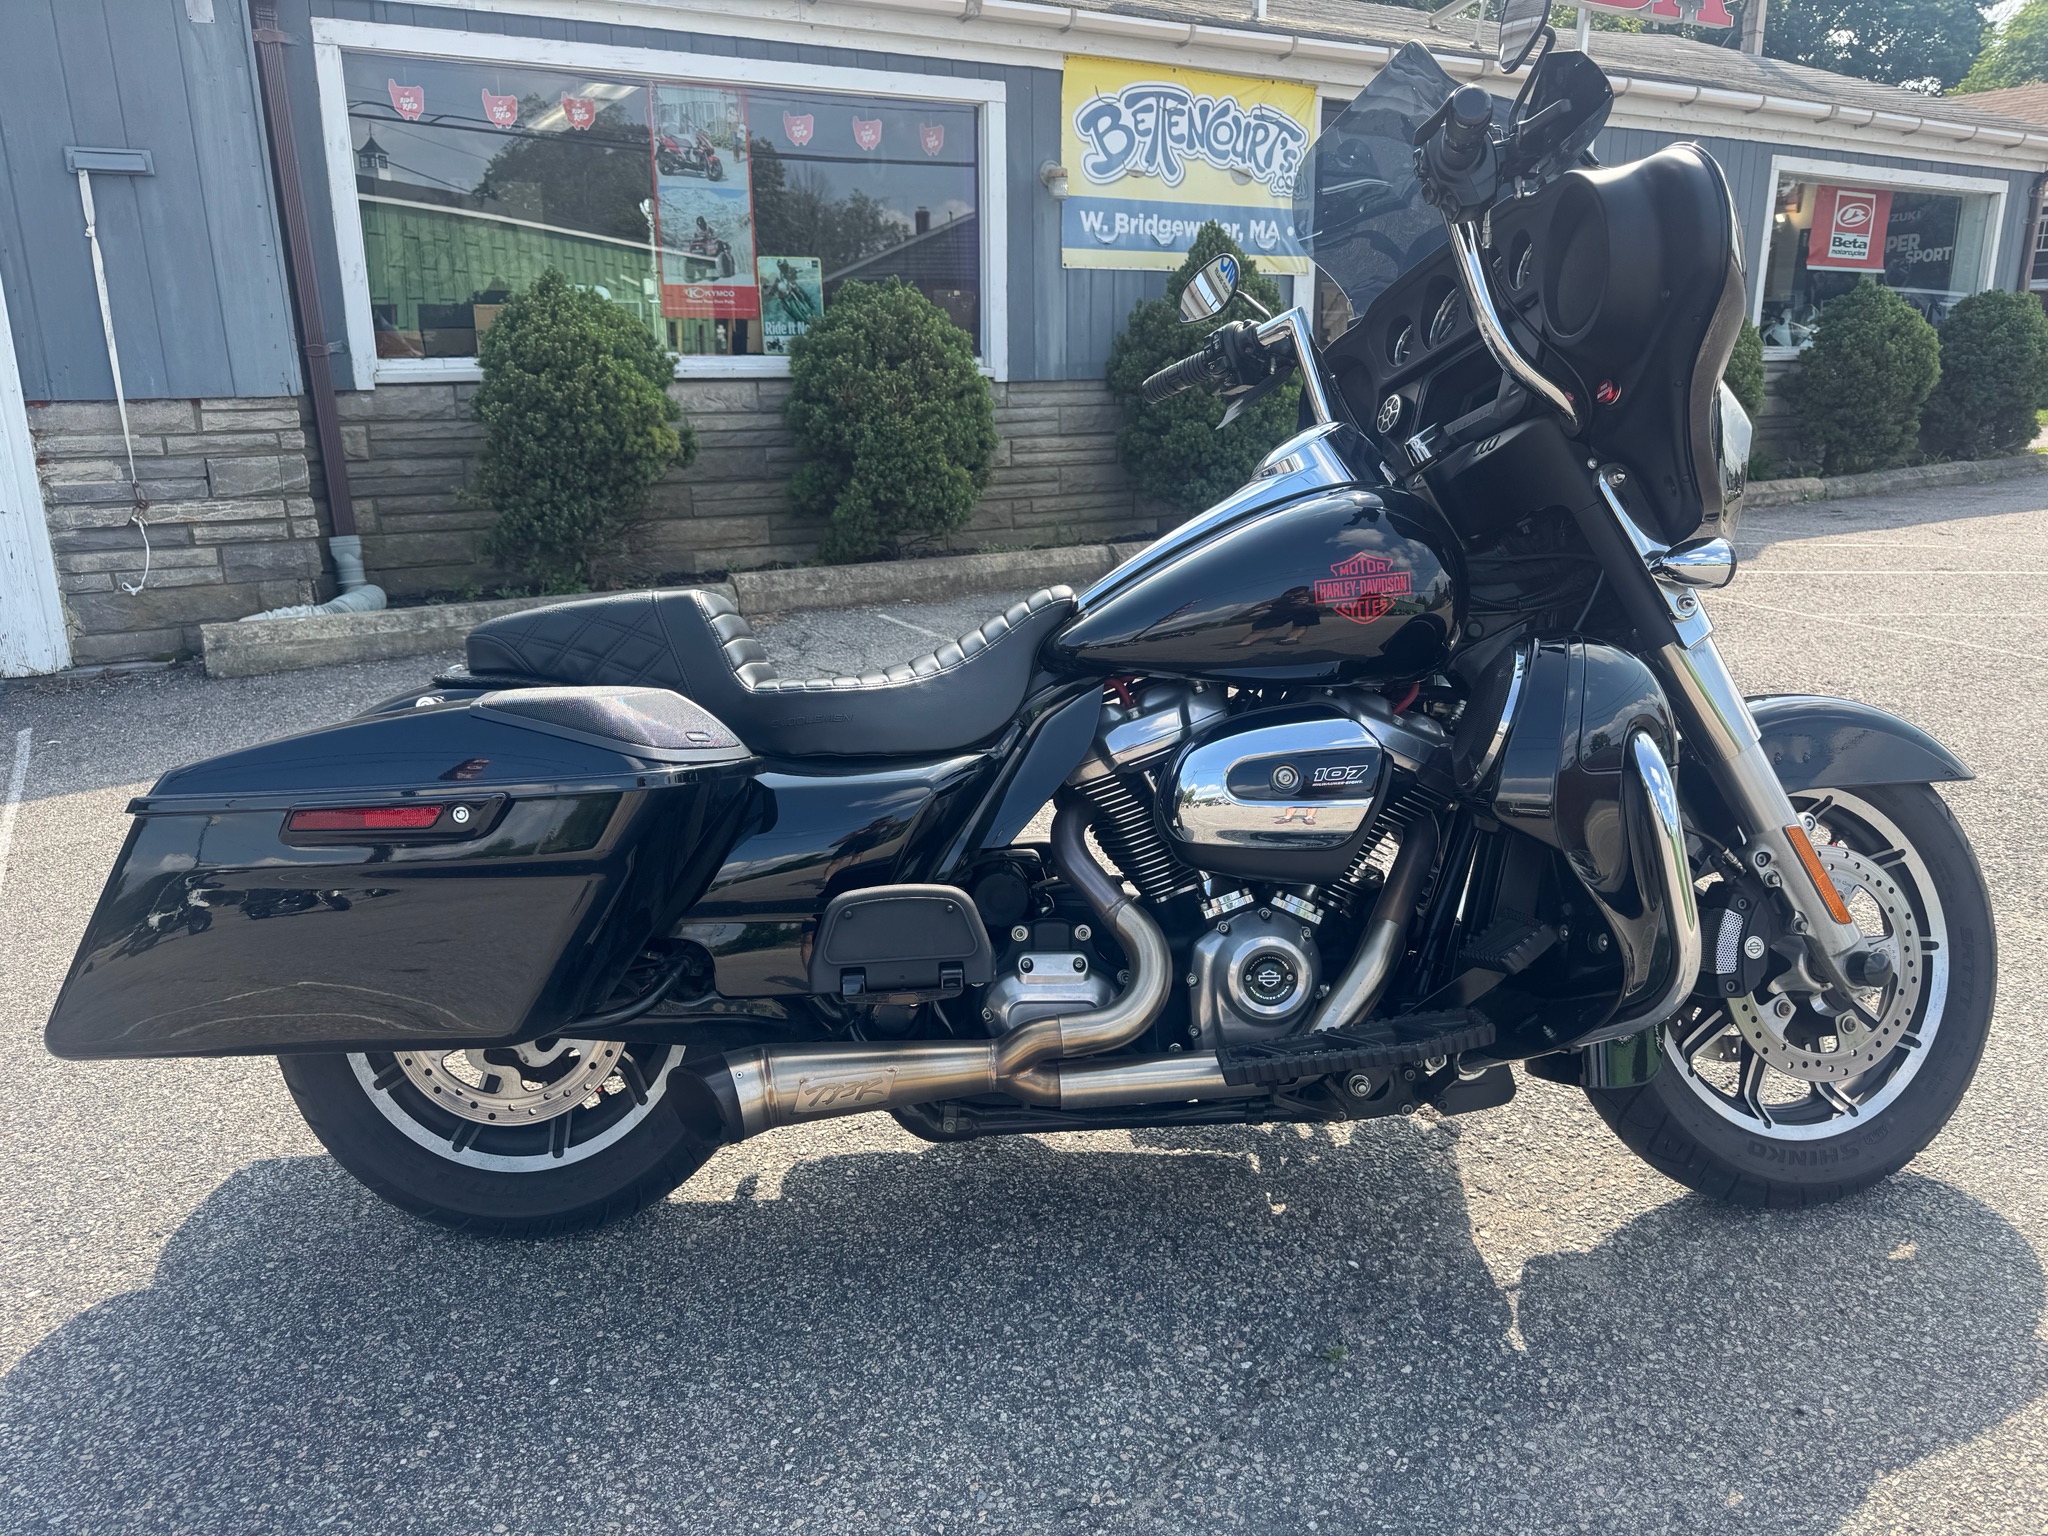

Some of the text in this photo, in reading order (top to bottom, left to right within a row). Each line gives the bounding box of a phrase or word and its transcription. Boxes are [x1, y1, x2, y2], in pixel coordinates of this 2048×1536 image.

[402, 102, 418, 112] RED
[495, 111, 512, 120] RED
[573, 113, 590, 122] RED
[1080, 90, 1303, 177] BETTENCOURT'S
[1890, 210, 1921, 223] ZUKI
[1080, 210, 1281, 242] W. Bridgewer, MA
[1832, 236, 1868, 249] Beta
[1886, 233, 1921, 254] PER
[1831, 249, 1866, 257] motorcycles
[1904, 246, 1953, 264] SPORT
[705, 289, 736, 298] KYMCO
[765, 320, 787, 335] Ride
[788, 321, 797, 335] It
[1339, 557, 1387, 576] MOTOR
[1319, 575, 1408, 599] HARLEY-DAVIDSON
[1341, 598, 1389, 621] CYCLES
[771, 713, 854, 729] SADDLEMEN
[1313, 764, 1369, 782] 107
[1748, 1140, 1860, 1167] SHINKO
